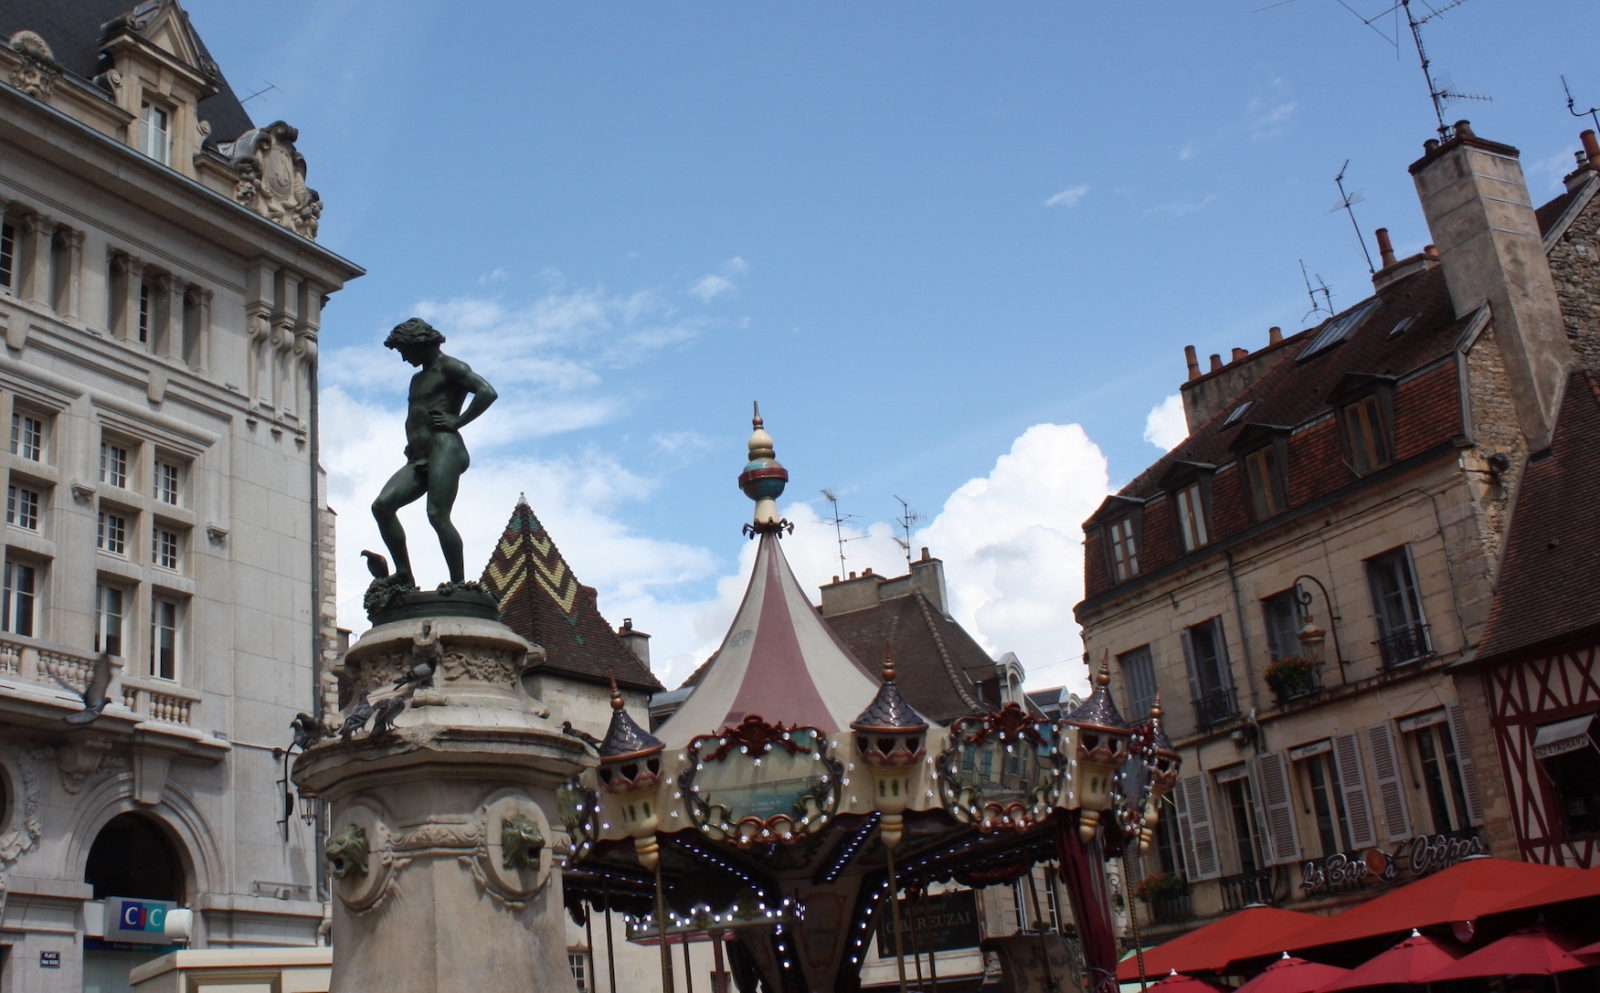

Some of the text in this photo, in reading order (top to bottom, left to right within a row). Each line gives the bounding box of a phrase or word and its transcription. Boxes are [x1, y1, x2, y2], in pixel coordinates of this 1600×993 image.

[1300, 862, 1324, 890] Le
[1325, 853, 1368, 886] Bar
[1409, 834, 1483, 875] Crêpes
[125, 907, 162, 927] CIC
